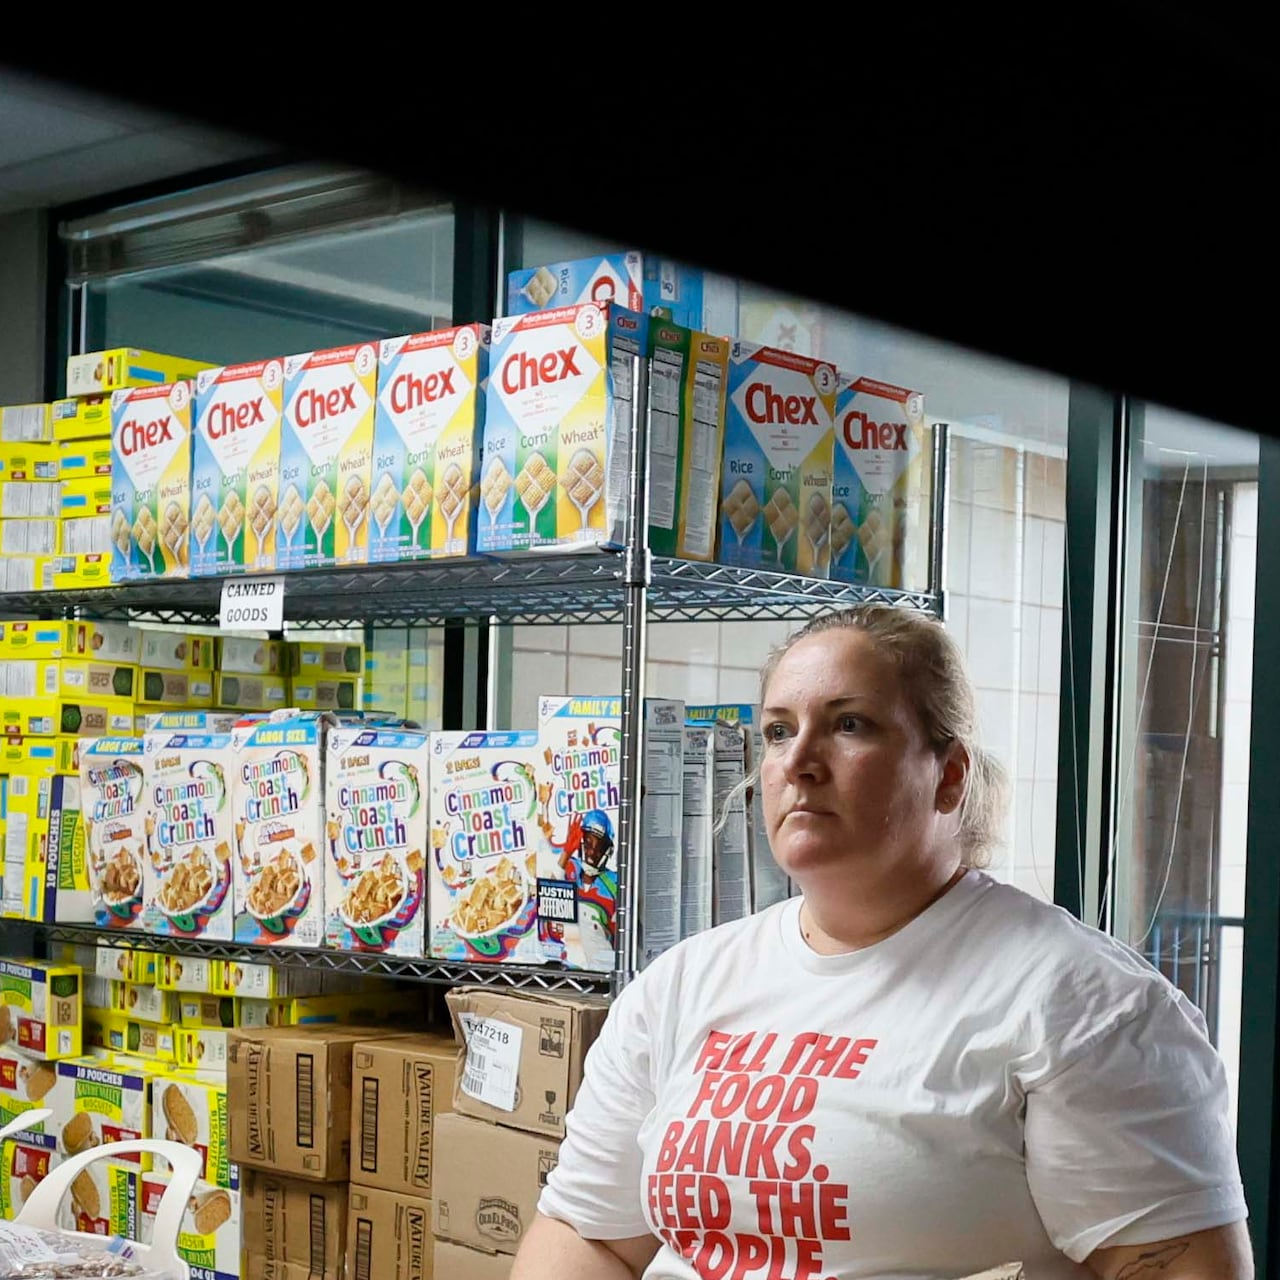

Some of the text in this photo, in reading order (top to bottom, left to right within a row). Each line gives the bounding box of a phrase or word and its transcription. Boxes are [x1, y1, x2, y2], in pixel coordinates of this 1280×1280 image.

[502, 345, 583, 395] Chex
[391, 367, 456, 414] Chex
[295, 383, 357, 428] Chex
[745, 382, 821, 425] Chex
[207, 396, 265, 440] Chex
[120, 415, 174, 456] Chex
[521, 432, 548, 449] Corn
[561, 429, 599, 446] Wheat
[843, 411, 909, 451] Chex
[407, 450, 429, 466] Corn
[438, 444, 465, 460] Wheat
[488, 438, 506, 454] Rice
[249, 467, 274, 481] Wheat
[340, 456, 366, 472] Wheat
[377, 454, 395, 469] Rice
[731, 461, 754, 475] Rice
[227, 582, 276, 597] CANNED
[226, 608, 269, 623] GOODS
[571, 701, 608, 716] FAMILY
[243, 755, 297, 780] Cinnamon
[554, 748, 618, 771] Cinnamon
[89, 766, 136, 784] Cinnamon
[252, 773, 288, 798] Toast
[565, 766, 605, 791] Toast
[101, 779, 129, 800] Toast
[156, 781, 213, 804] Cinnamon
[341, 783, 405, 806] Cinnamon
[448, 784, 523, 812] Cinnamon
[558, 781, 619, 813] Crunch
[95, 792, 133, 819] Crunch
[166, 800, 204, 822] Toast
[248, 787, 298, 819] Crunch
[352, 802, 394, 827] Toast
[160, 813, 214, 844] Crunch
[463, 804, 511, 832] Toast
[346, 818, 406, 850] Crunch
[454, 820, 525, 858] Crunch
[46, 809, 61, 888] 10 POUCHES
[538, 886, 574, 899] JUSTIN
[538, 897, 575, 920] JEFFERSON
[778, 1031, 878, 1080] THE
[86, 1069, 124, 1086] POUCHES
[248, 1046, 263, 1155] NATURE VALLEY
[686, 1071, 819, 1123] FOOD
[210, 1109, 219, 1168] BISCUITS
[414, 1067, 432, 1186] NATURE VALLEY
[655, 1120, 830, 1183] BANKS.
[647, 1174, 852, 1241] FEED THE
[409, 1212, 424, 1271] NATURE
